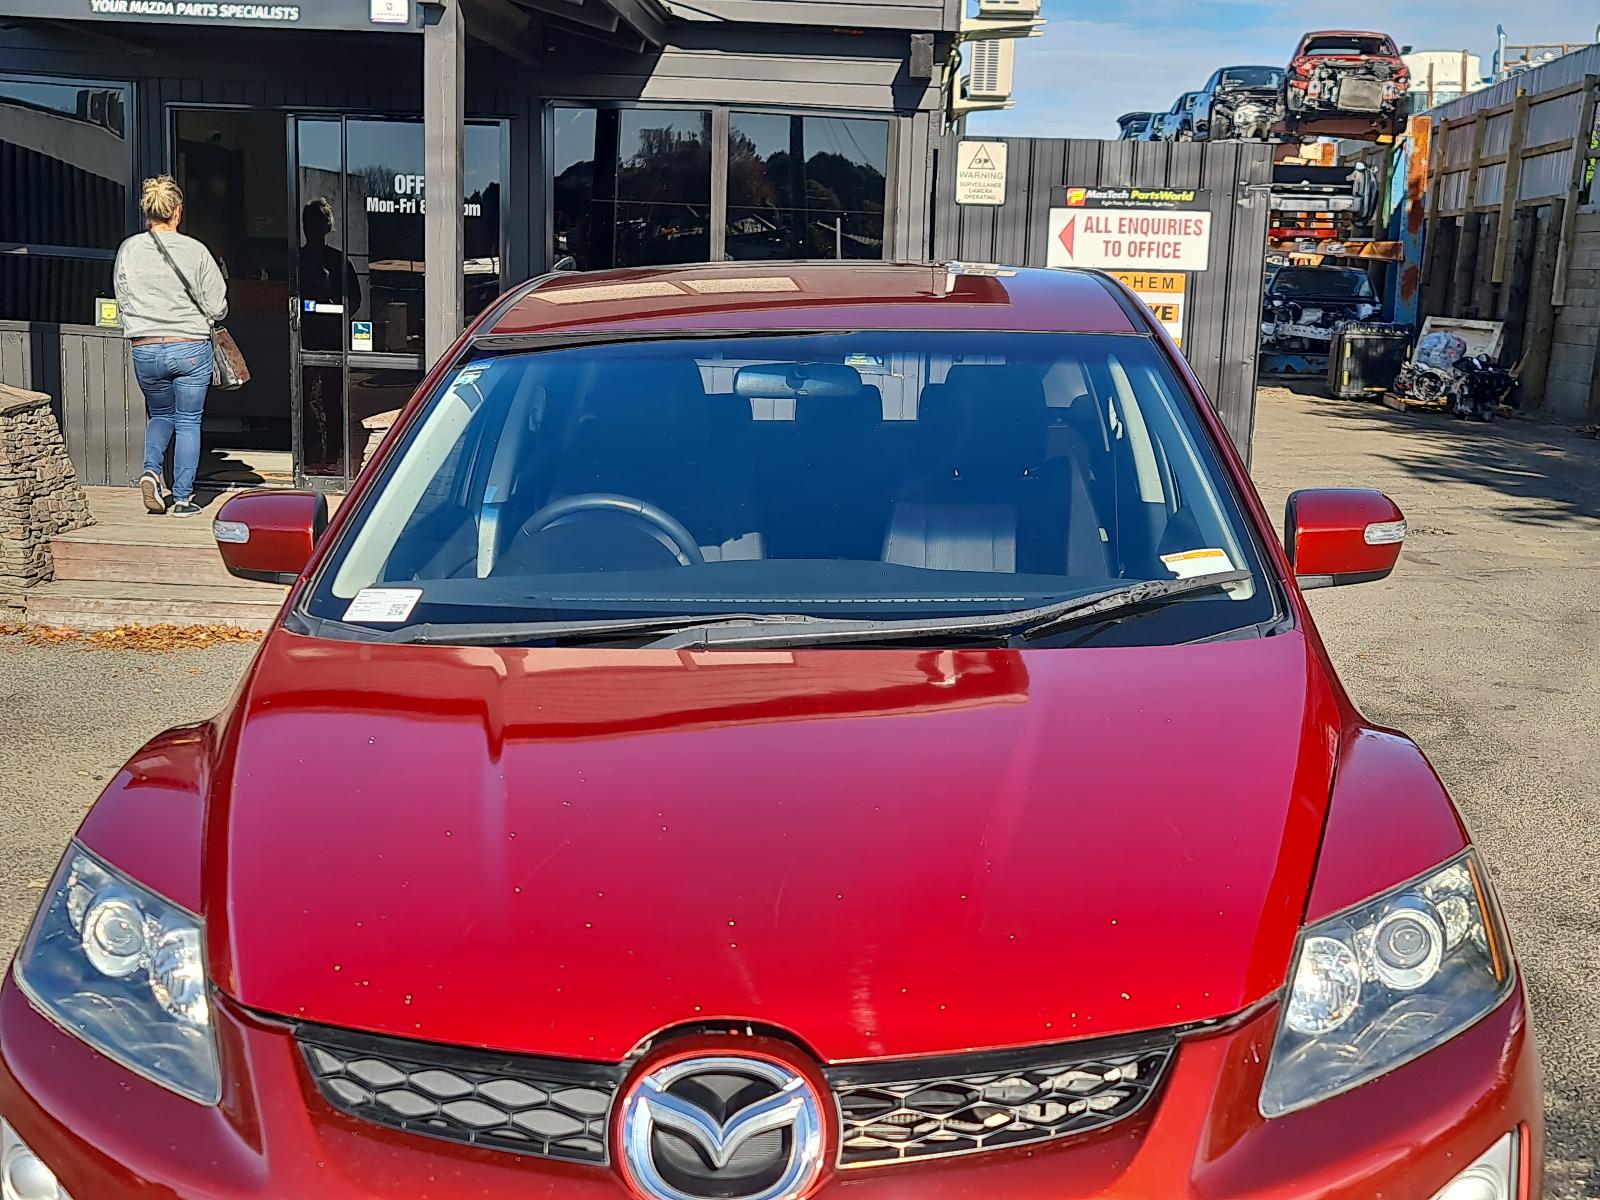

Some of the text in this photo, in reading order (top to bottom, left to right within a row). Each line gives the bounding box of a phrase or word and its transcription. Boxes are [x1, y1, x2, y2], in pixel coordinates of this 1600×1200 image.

[91, 0, 299, 20] YOUR MAZDA PARTS SPECIALISTS
[394, 174, 425, 195] OFF
[960, 171, 1004, 180] WARNING
[366, 196, 416, 214] Mon-Fri
[1130, 190, 1195, 202] PartsWorld
[1083, 216, 1204, 236] ALL ENQUIRIES
[1103, 239, 1182, 259] TO OFFICE
